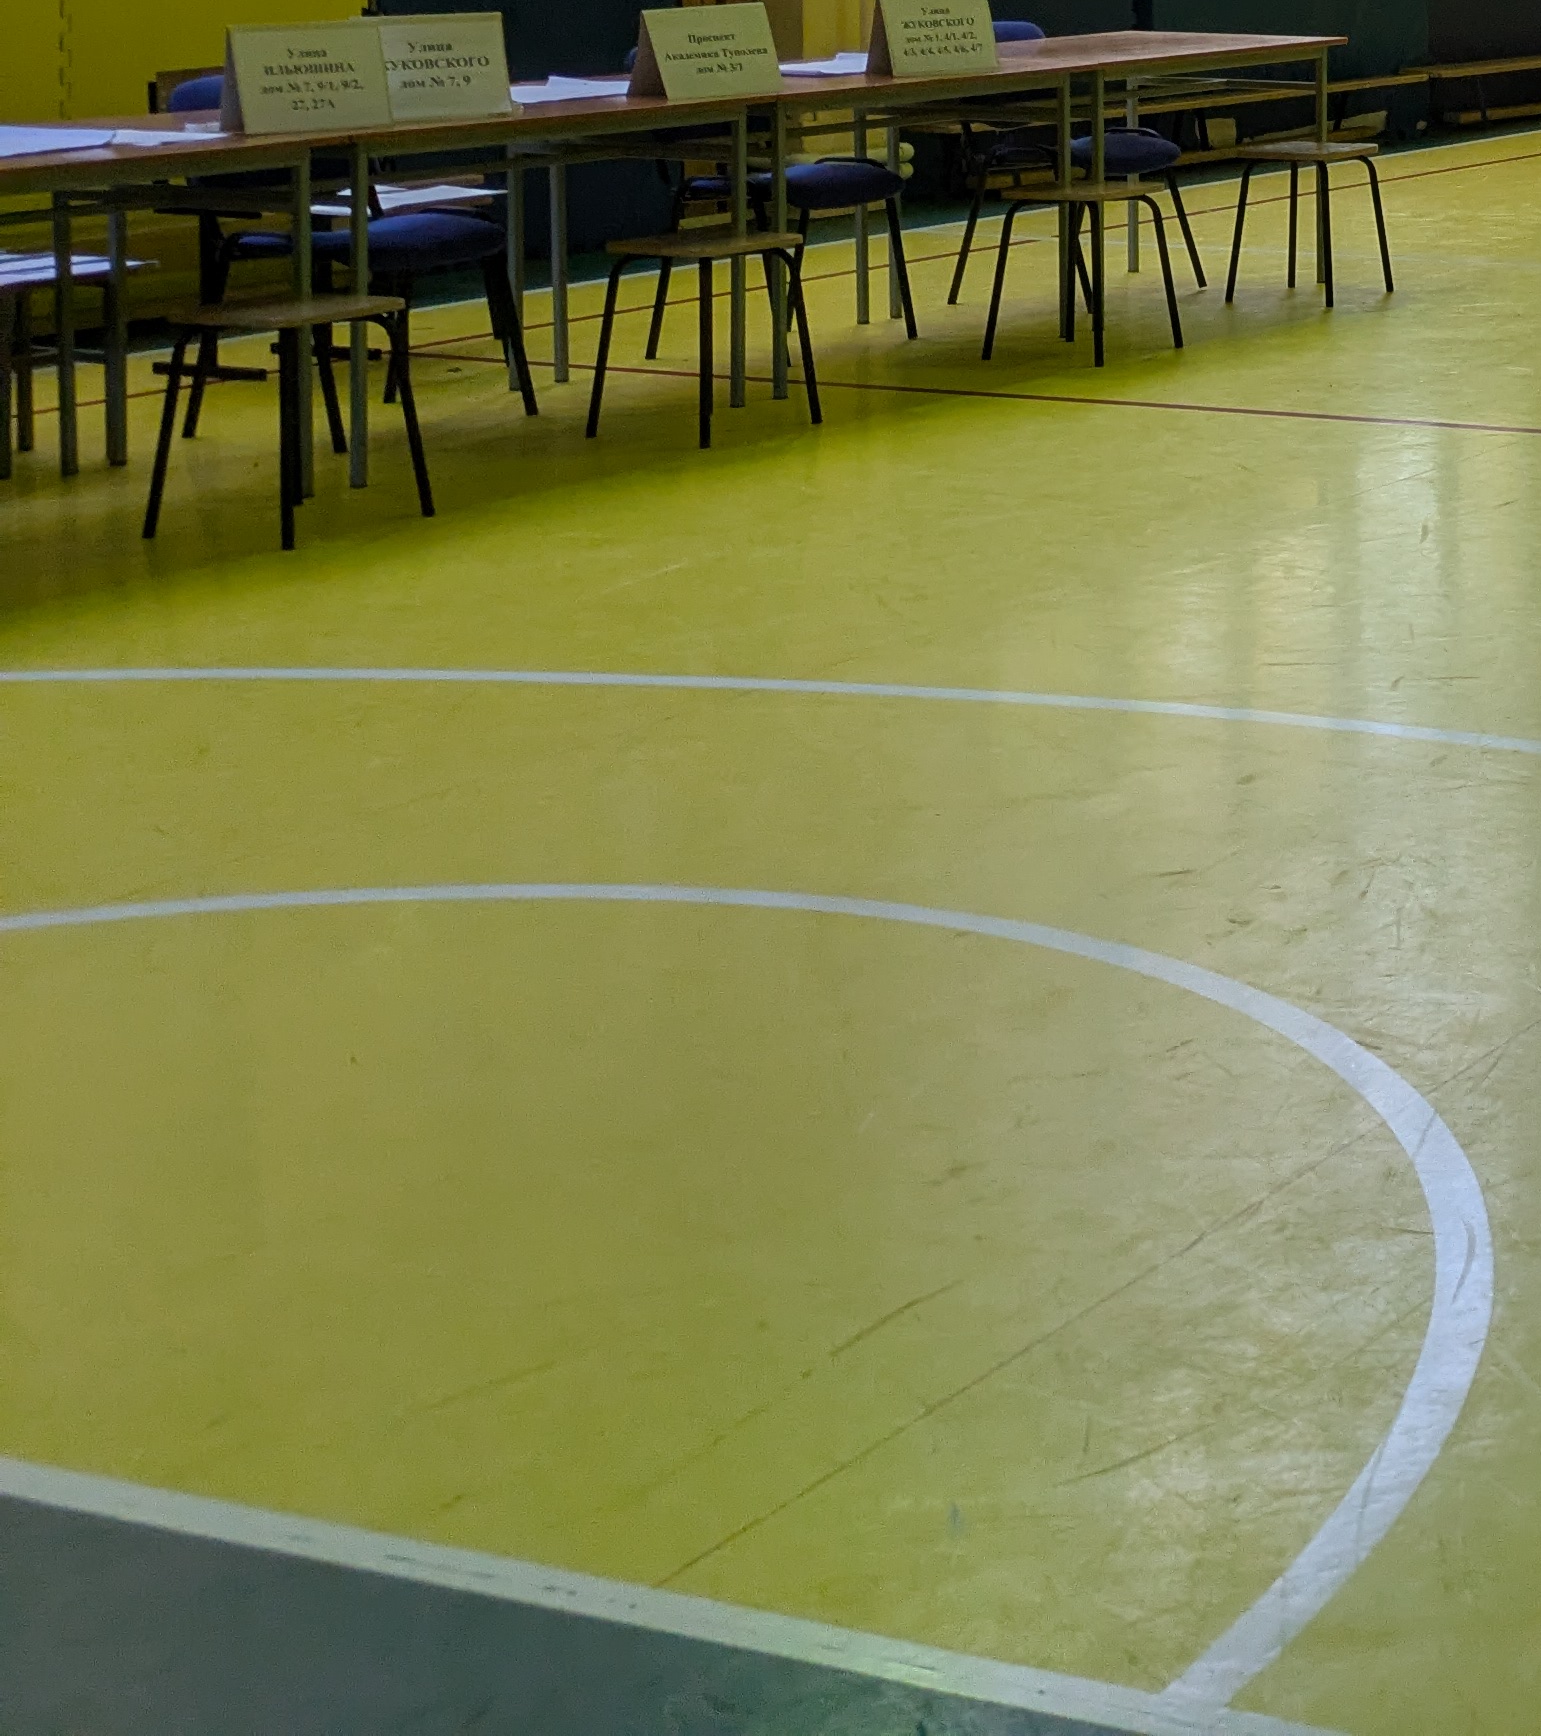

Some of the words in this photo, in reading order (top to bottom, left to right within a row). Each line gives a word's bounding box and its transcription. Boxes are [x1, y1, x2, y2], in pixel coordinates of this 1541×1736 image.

[687, 33, 735, 45] Проспект
[408, 42, 453, 53] Улица
[665, 51, 719, 62] Академика
[463, 75, 471, 86] 9
